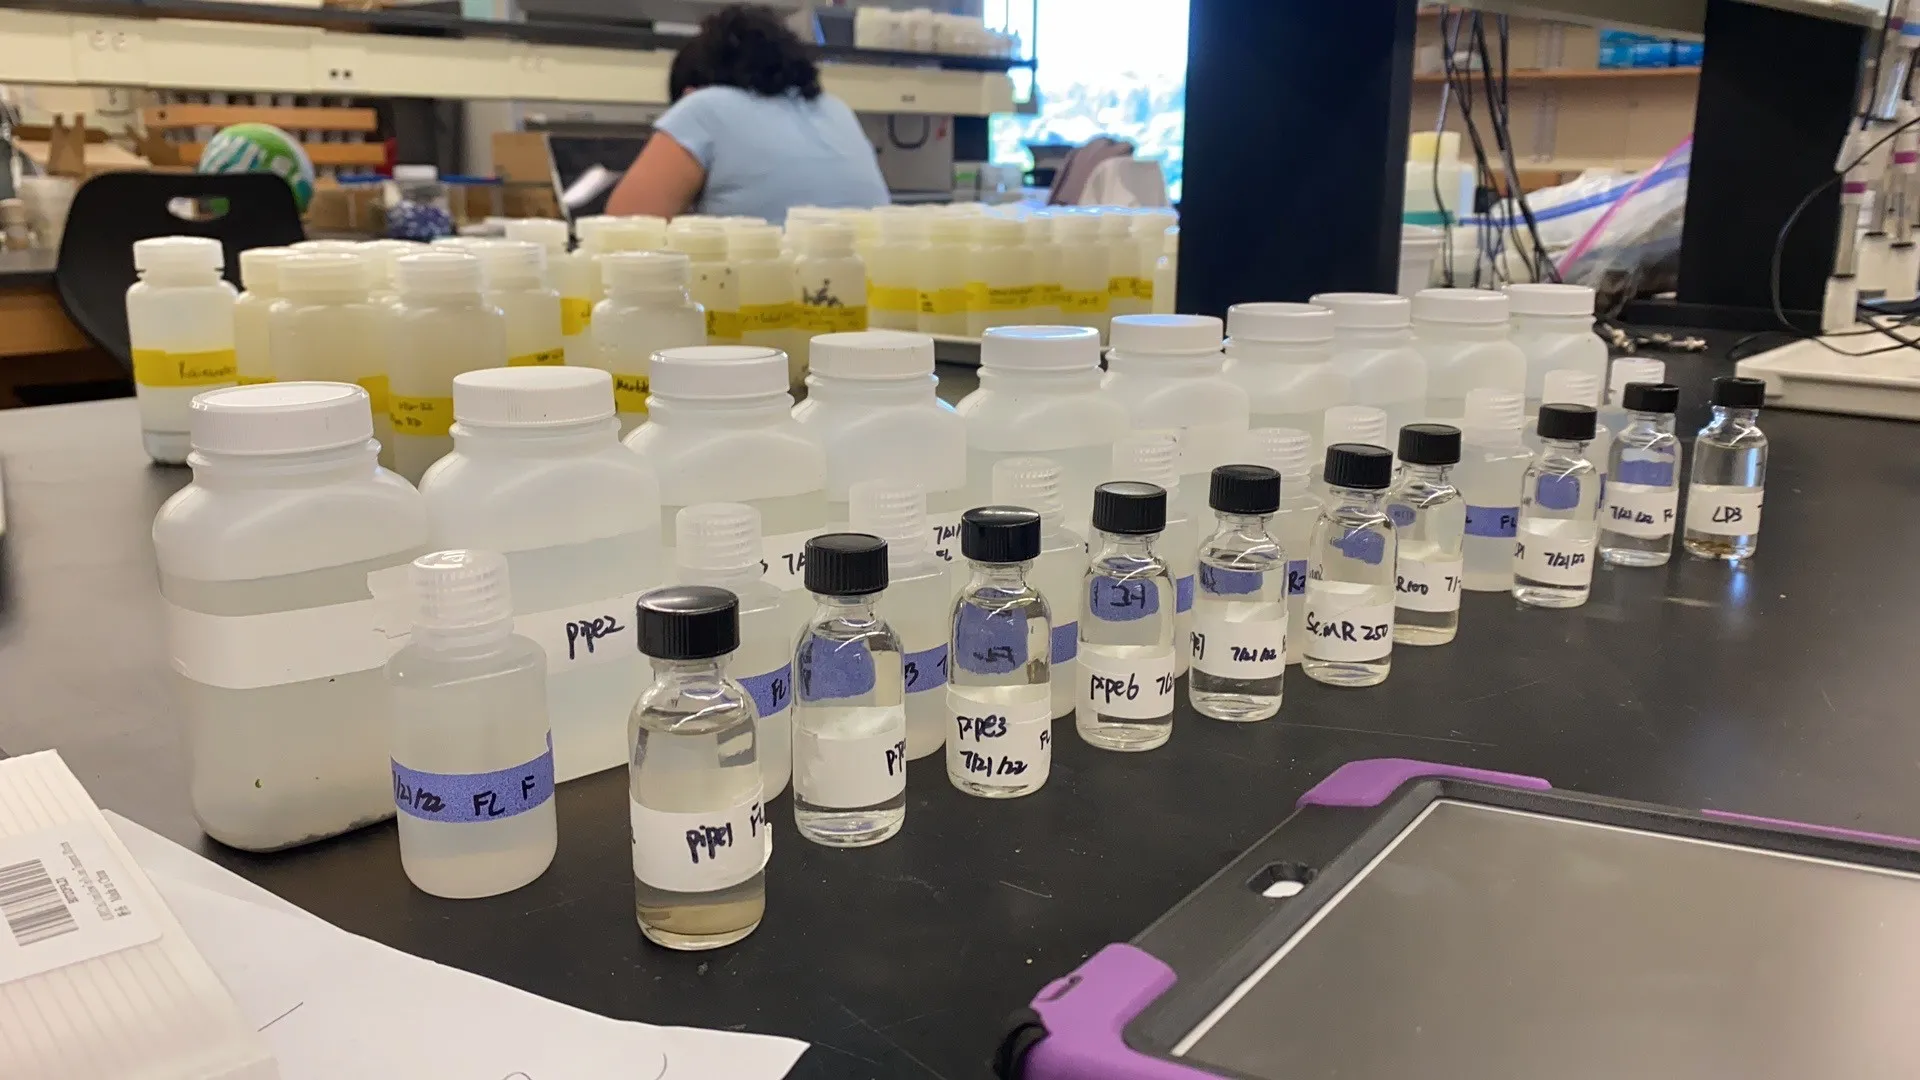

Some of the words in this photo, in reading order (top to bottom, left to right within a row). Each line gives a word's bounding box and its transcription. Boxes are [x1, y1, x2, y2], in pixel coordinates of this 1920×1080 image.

[565, 615, 625, 661] pipe2
[1090, 672, 1139, 704] pipe6
[956, 713, 1008, 743] pipe3
[959, 749, 1029, 778] 7/21/22
[472, 789, 506, 817] FL
[520, 774, 536, 800] F
[685, 821, 734, 865] pipe1
